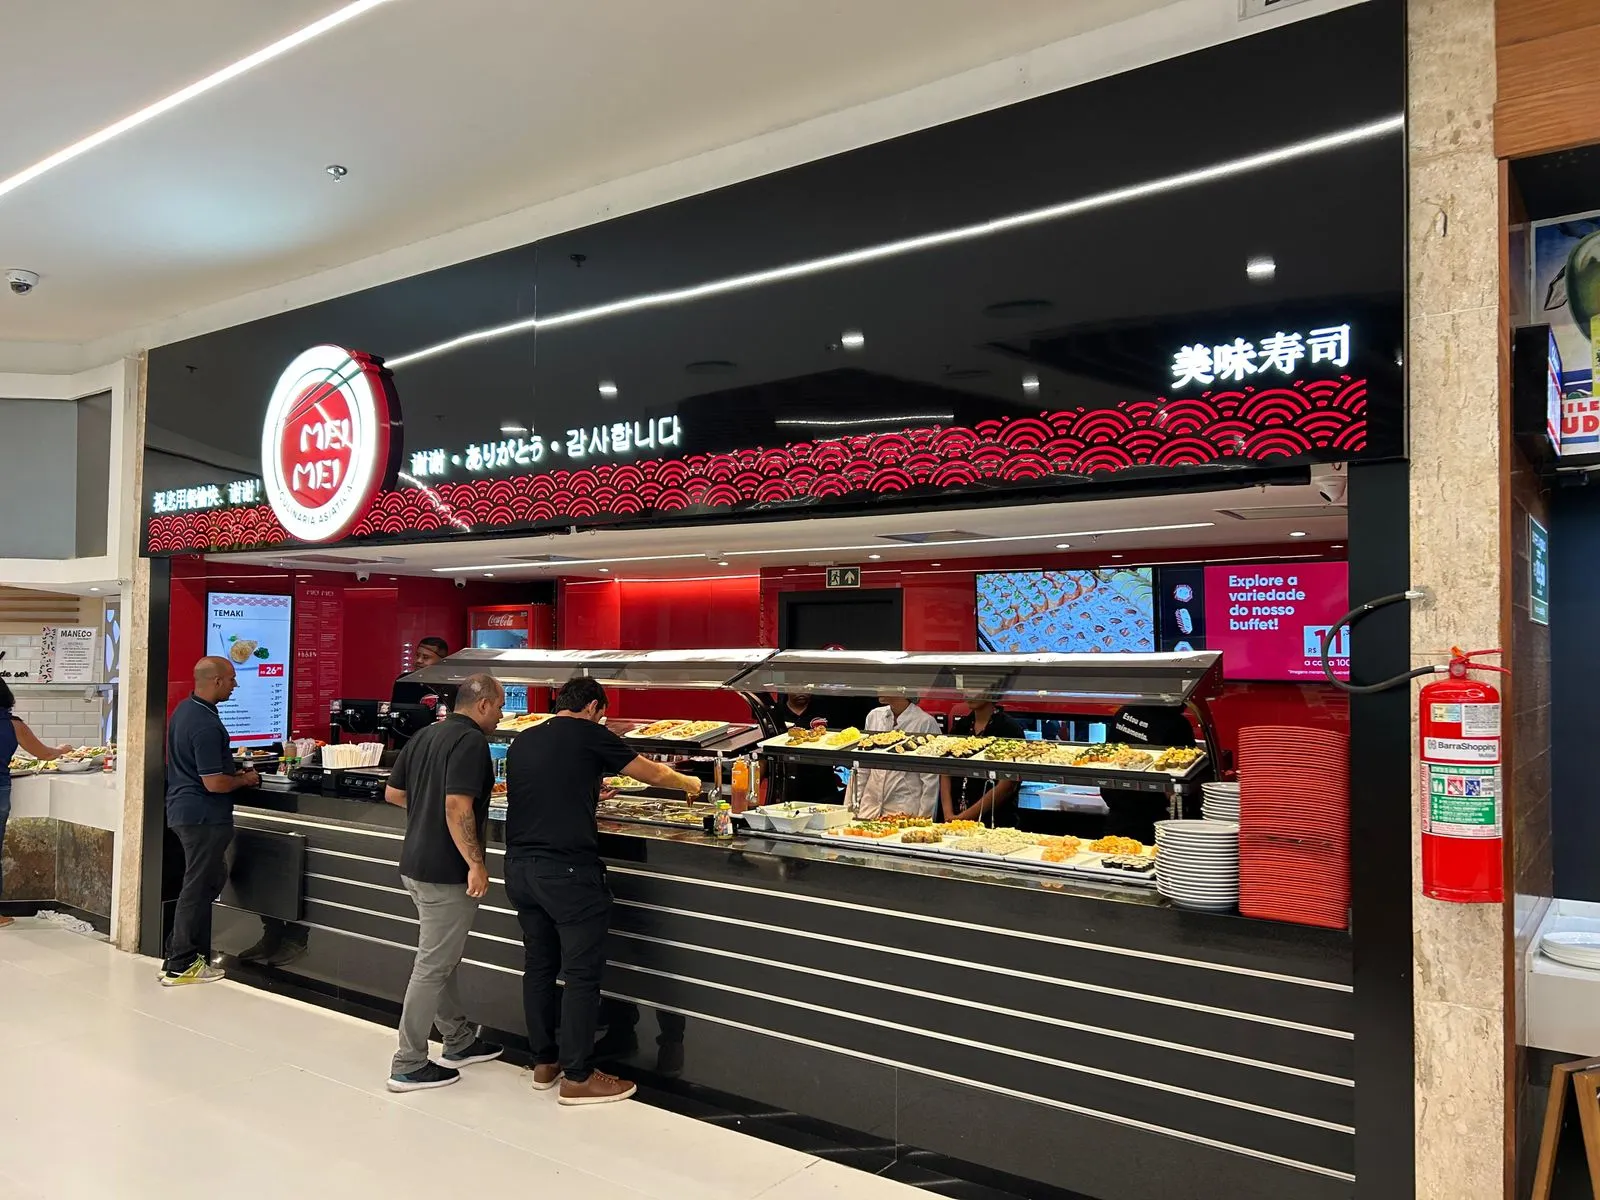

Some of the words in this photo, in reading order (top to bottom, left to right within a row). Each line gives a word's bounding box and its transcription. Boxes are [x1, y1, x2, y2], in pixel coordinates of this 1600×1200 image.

[1171, 323, 1350, 389] 美味寿司
[465, 435, 543, 471] ありがとう
[566, 415, 681, 457] 감사합니다
[292, 458, 340, 491] MEI
[1229, 574, 1283, 589] Explore
[1287, 576, 1298, 586] a
[1229, 588, 1306, 601] variedade
[213, 609, 244, 617] TEMAKI
[1229, 604, 1248, 616] do
[1252, 605, 1295, 616] nosso
[1229, 618, 1279, 630] buffet!
[1438, 741, 1496, 752] BarraShopping
